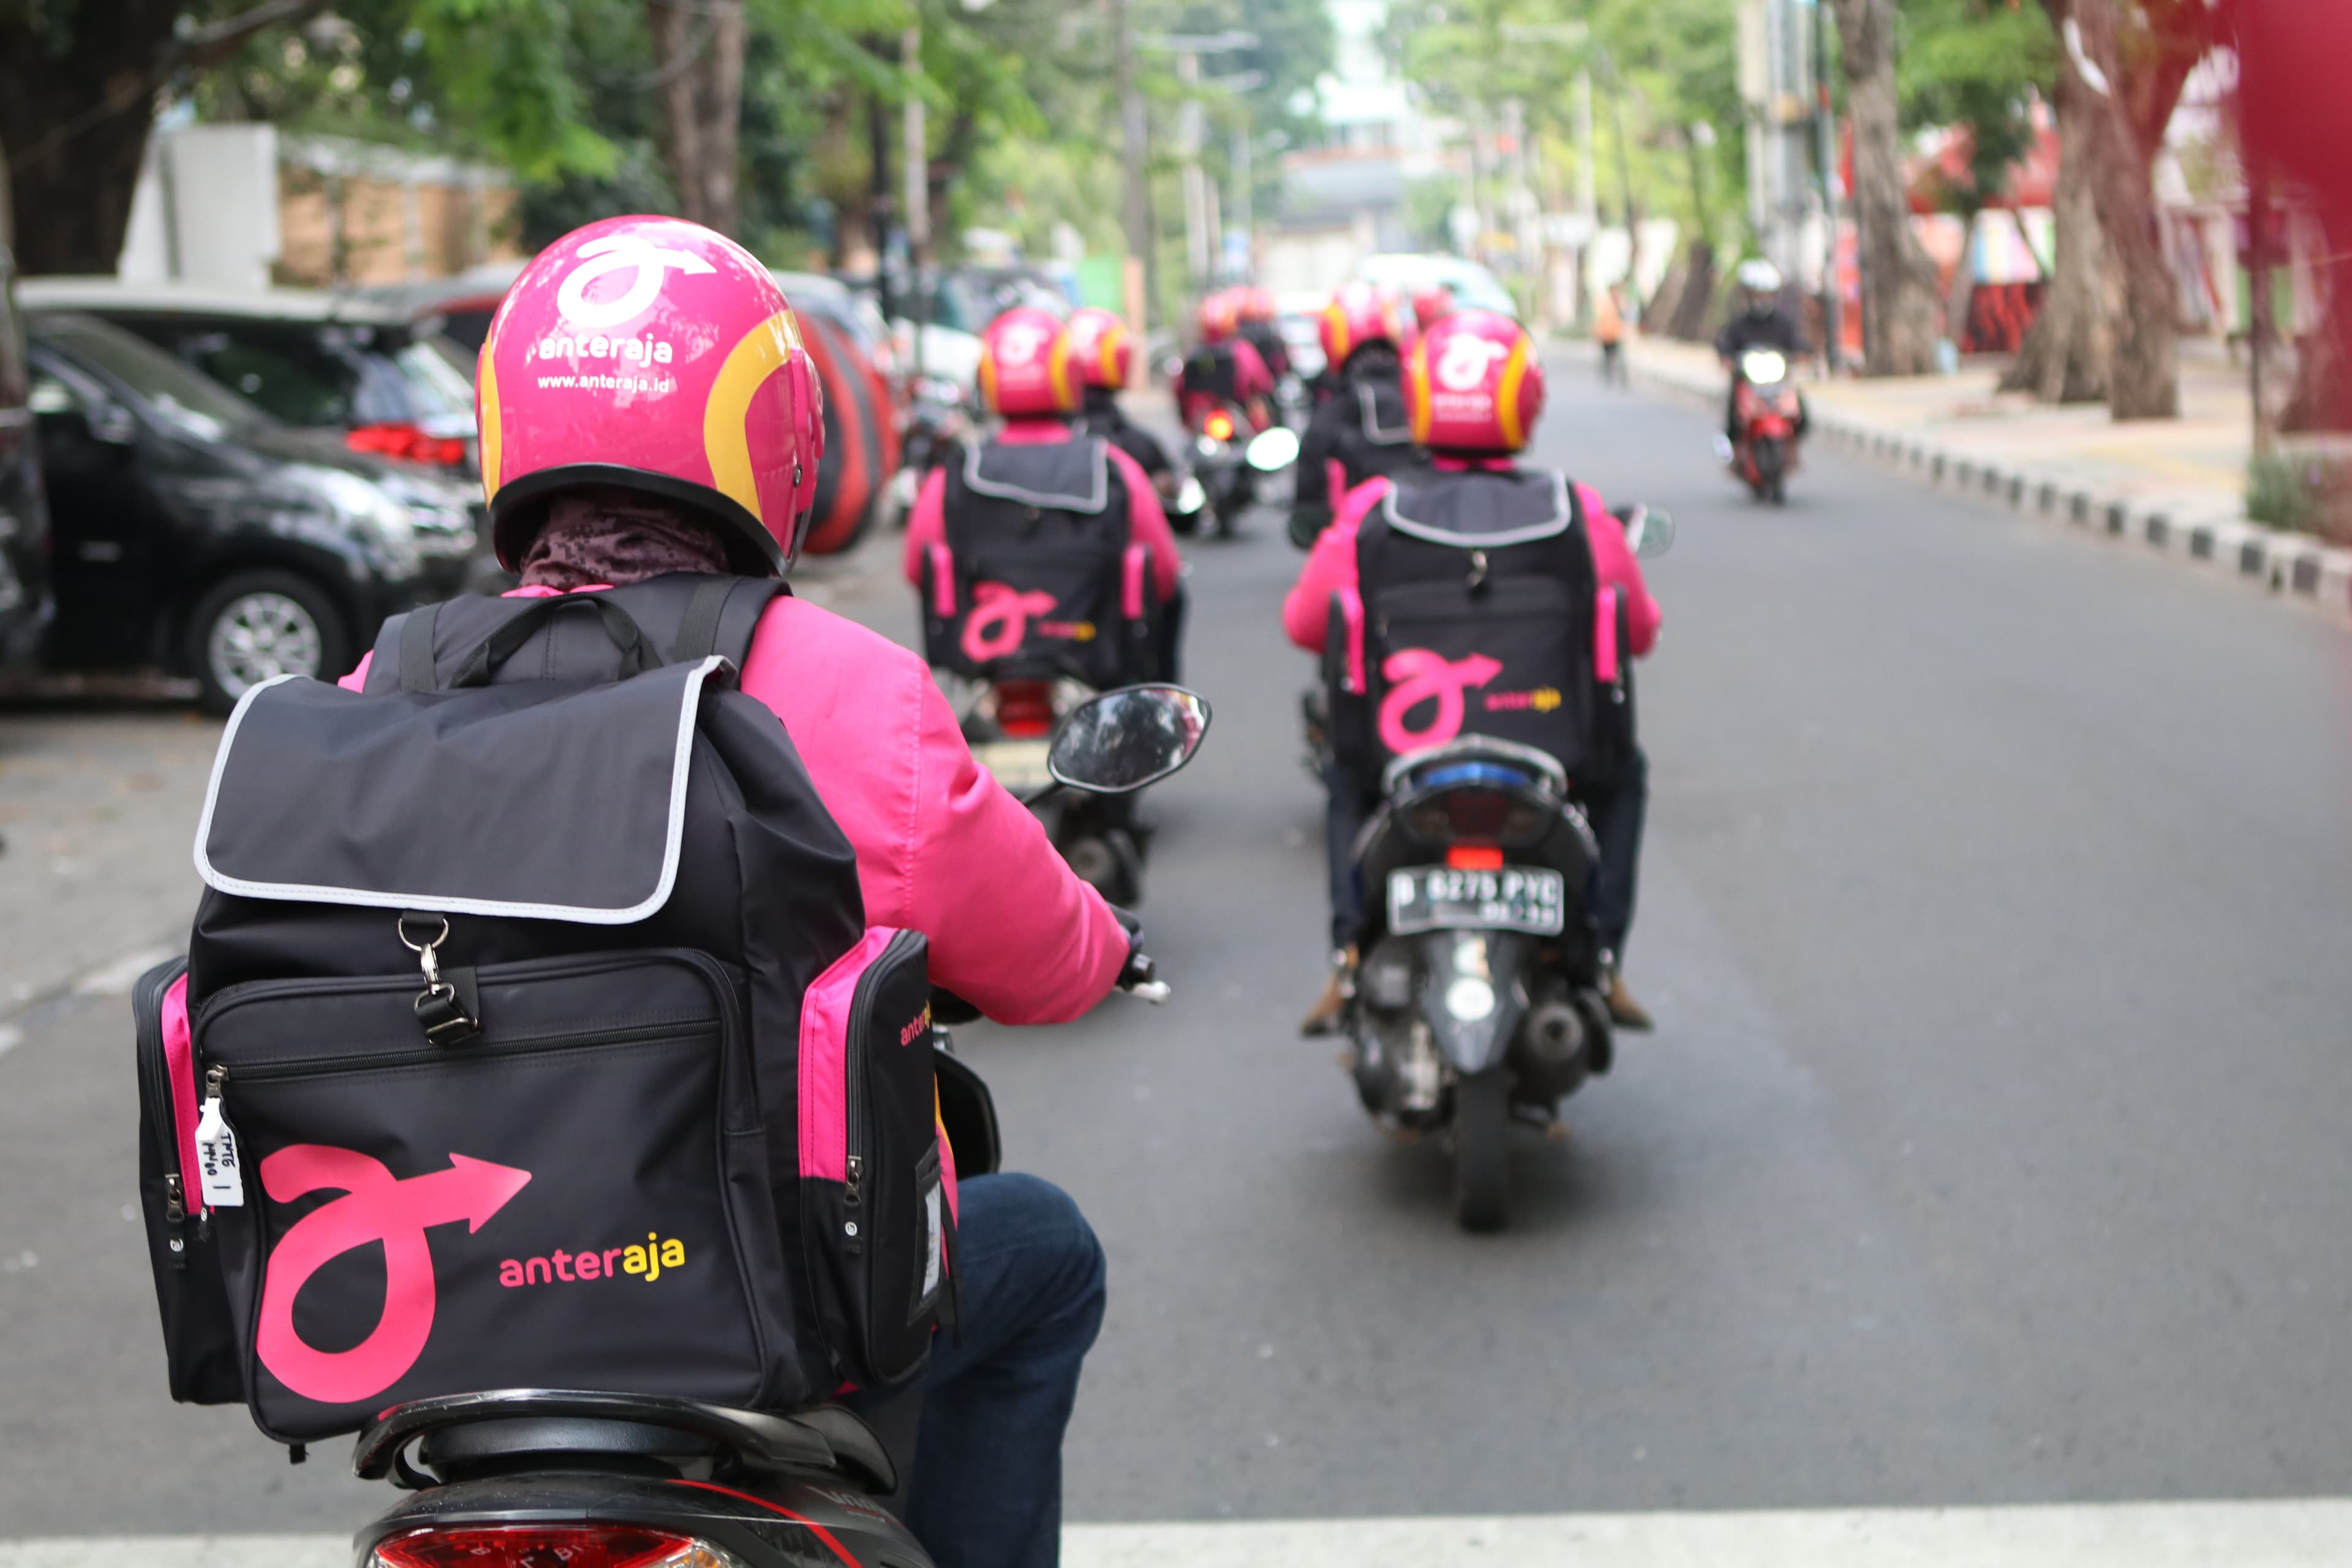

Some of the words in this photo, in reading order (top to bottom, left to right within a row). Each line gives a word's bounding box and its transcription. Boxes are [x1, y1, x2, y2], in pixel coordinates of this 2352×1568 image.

[538, 333, 673, 368] anteraja
[537, 373, 669, 393] www.anteraja.id
[499, 1231, 685, 1287] anteraja
